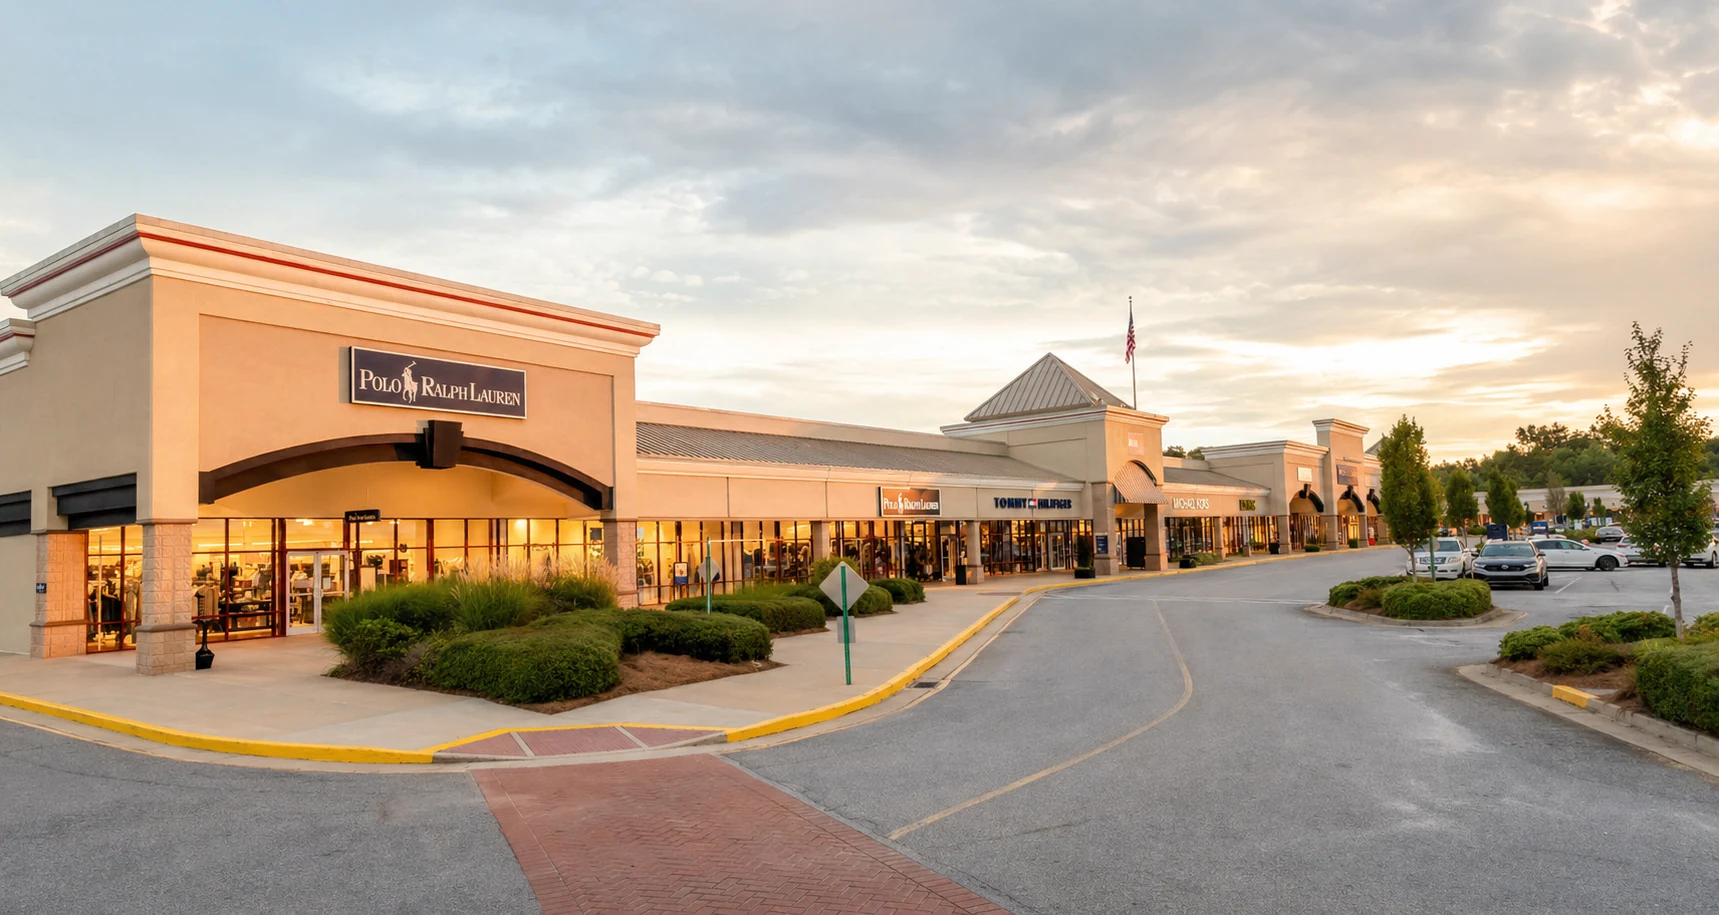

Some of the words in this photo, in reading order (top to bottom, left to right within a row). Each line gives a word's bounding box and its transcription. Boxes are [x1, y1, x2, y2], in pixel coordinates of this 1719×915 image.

[359, 369, 401, 393] POLO
[421, 376, 468, 401] RALPH
[469, 382, 521, 406] LAUREN
[993, 497, 1027, 509] TOMMY
